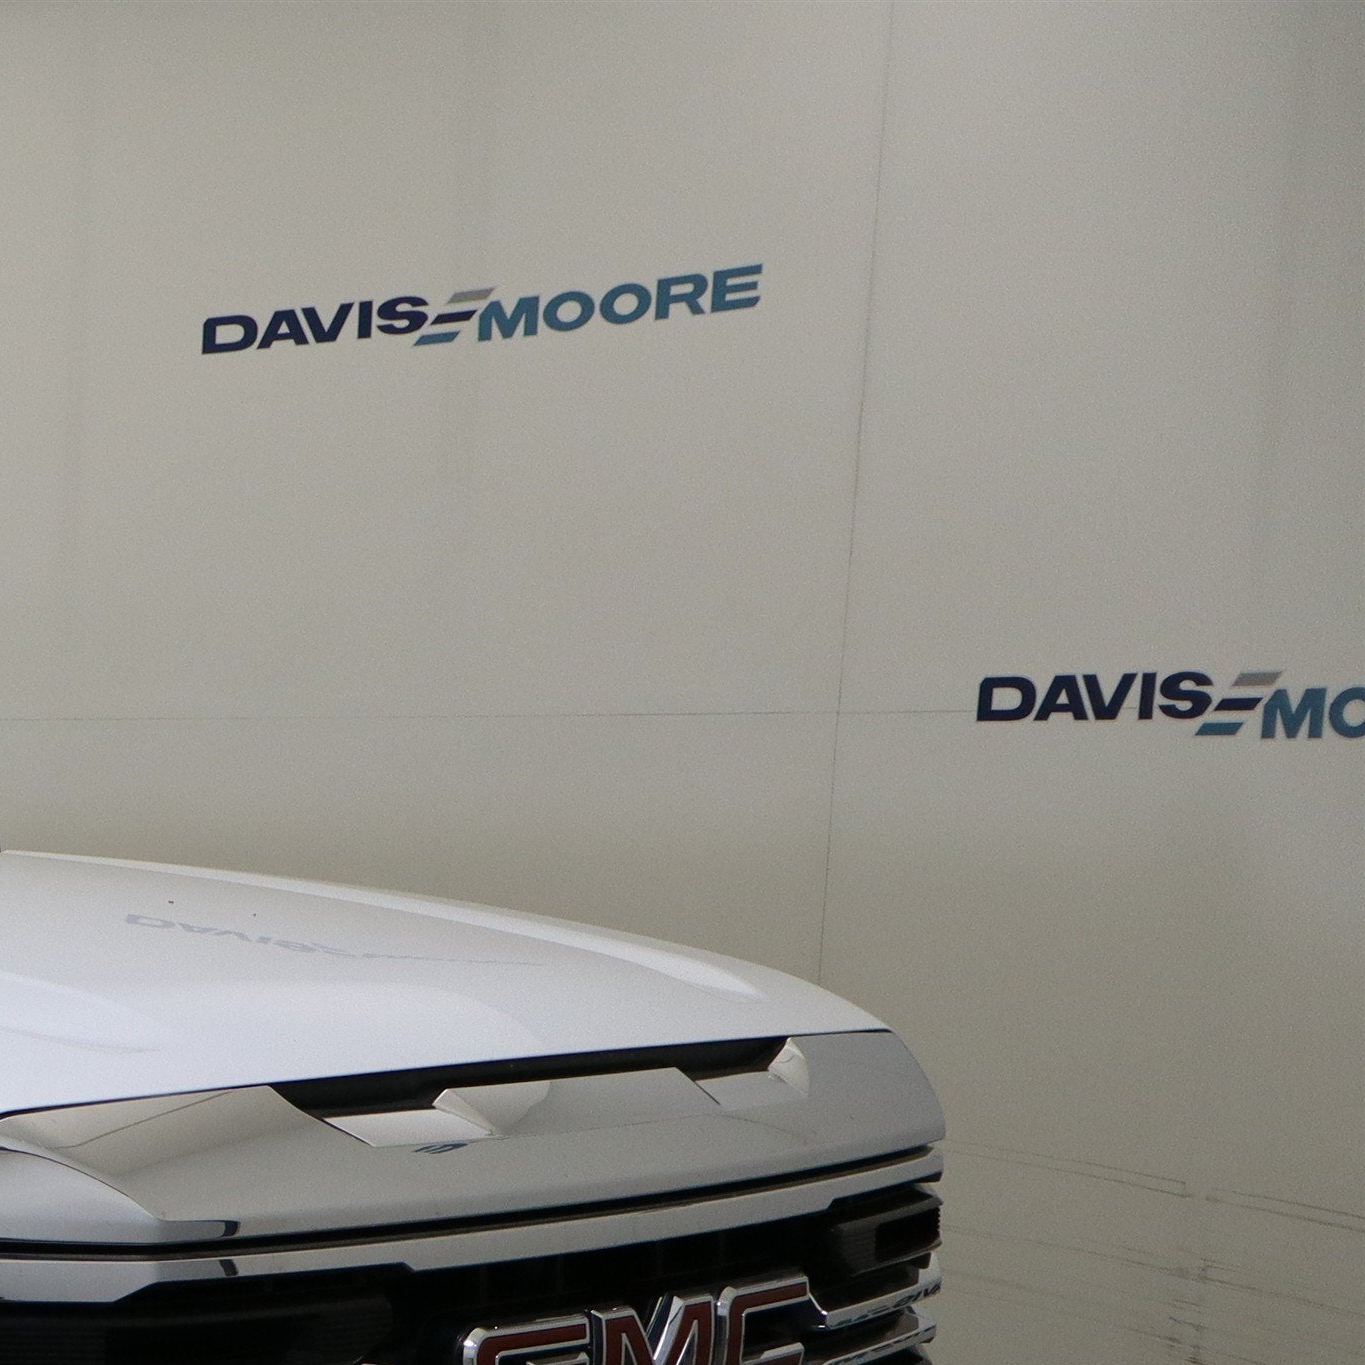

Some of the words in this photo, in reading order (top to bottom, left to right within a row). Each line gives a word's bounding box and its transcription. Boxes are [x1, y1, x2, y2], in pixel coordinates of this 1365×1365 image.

[201, 294, 429, 355] DAVIS
[477, 263, 763, 342] MOORE
[976, 671, 1214, 722] DAVIS
